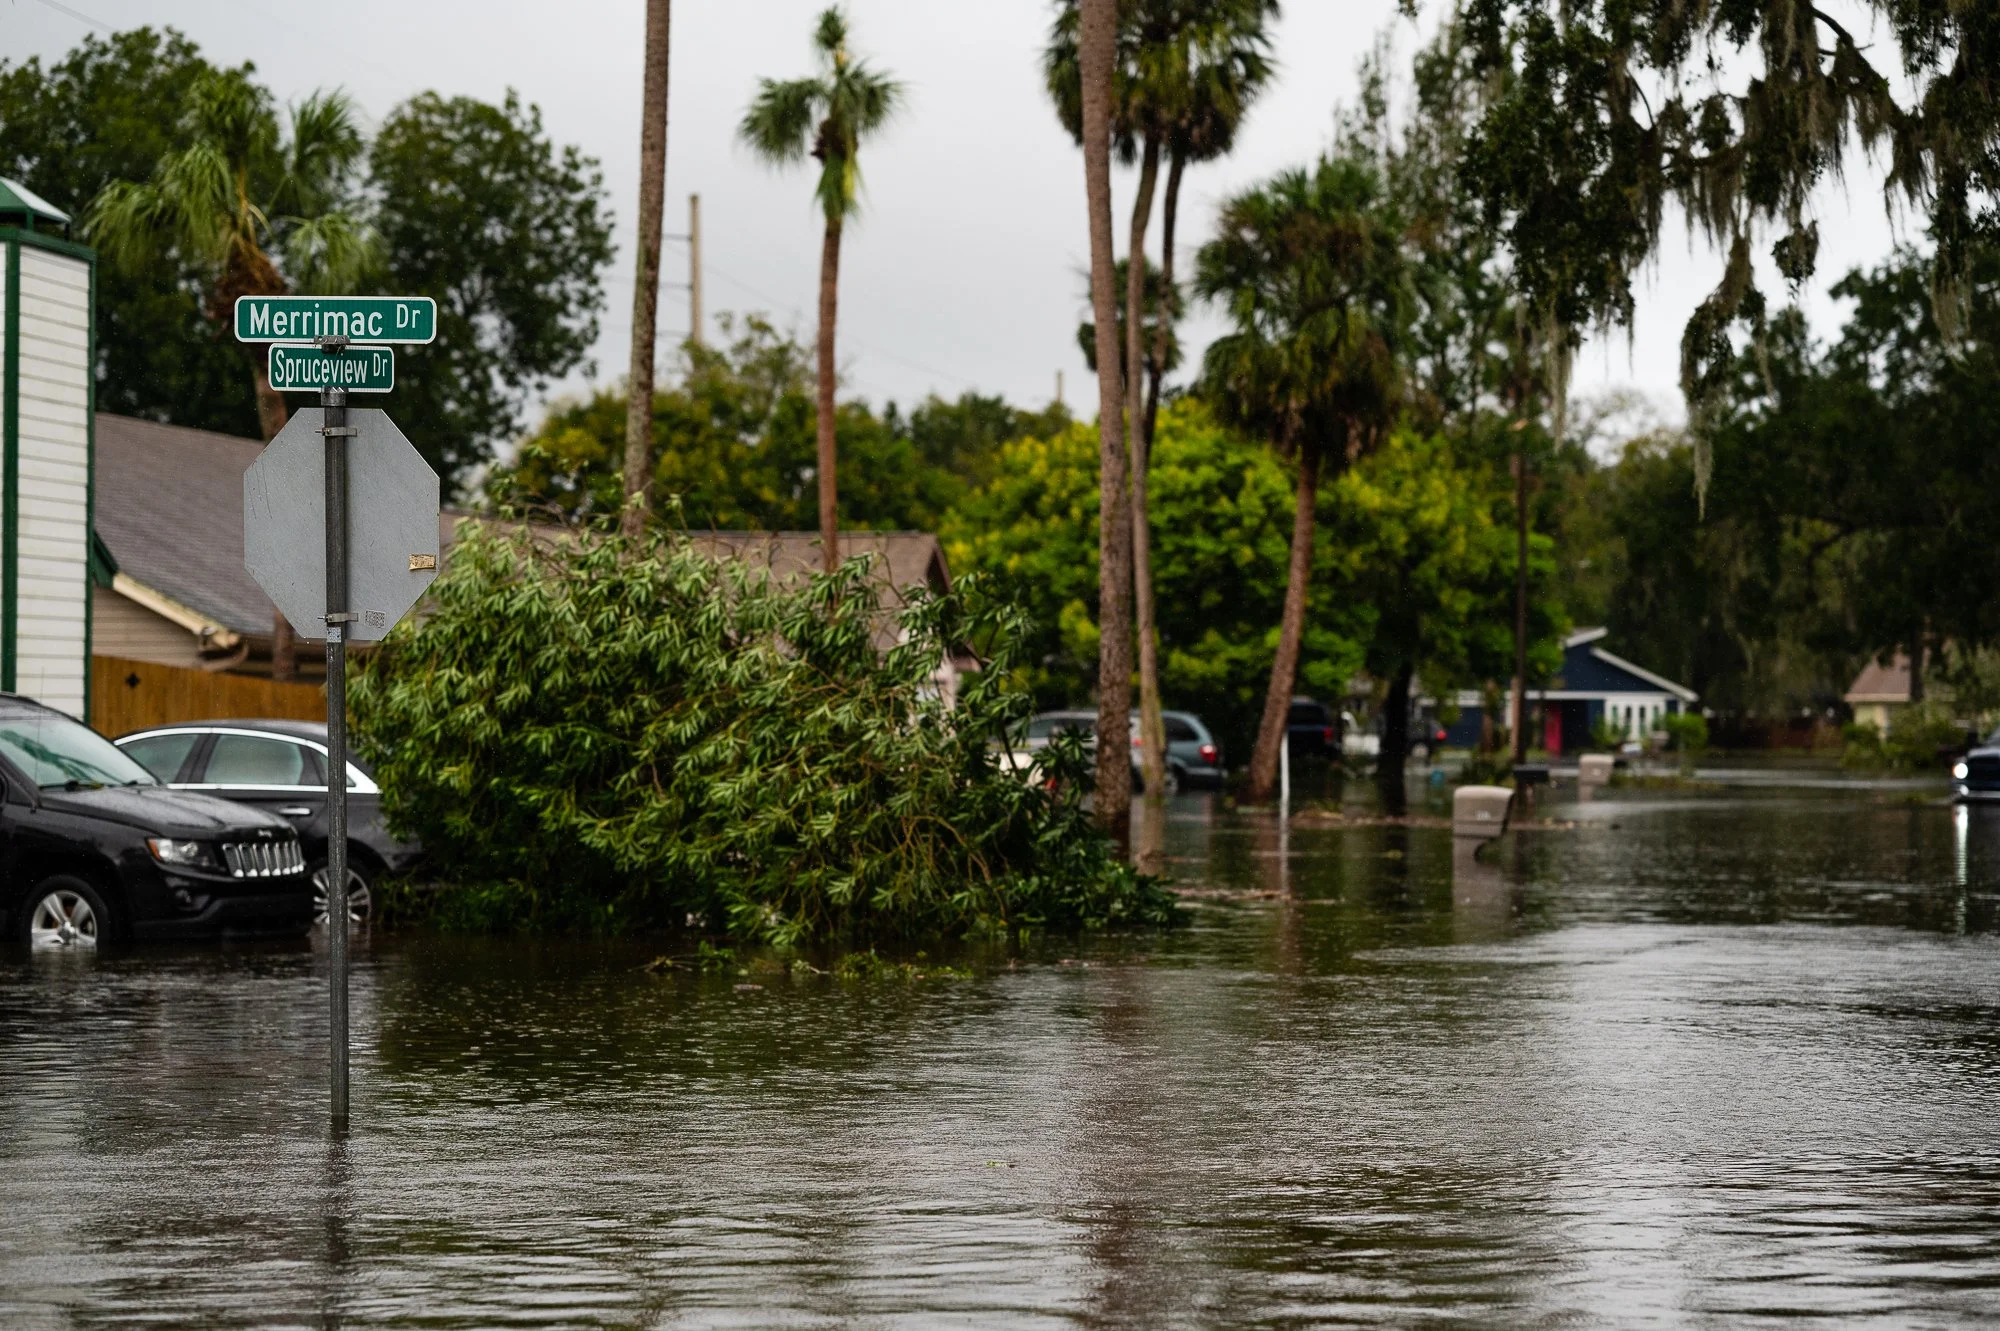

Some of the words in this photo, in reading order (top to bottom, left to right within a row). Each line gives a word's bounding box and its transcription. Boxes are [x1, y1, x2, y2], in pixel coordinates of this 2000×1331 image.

[250, 303, 383, 336] Merrimac
[396, 304, 421, 329] Dr
[274, 349, 368, 388] Spruceview
[373, 353, 388, 377] Dr
